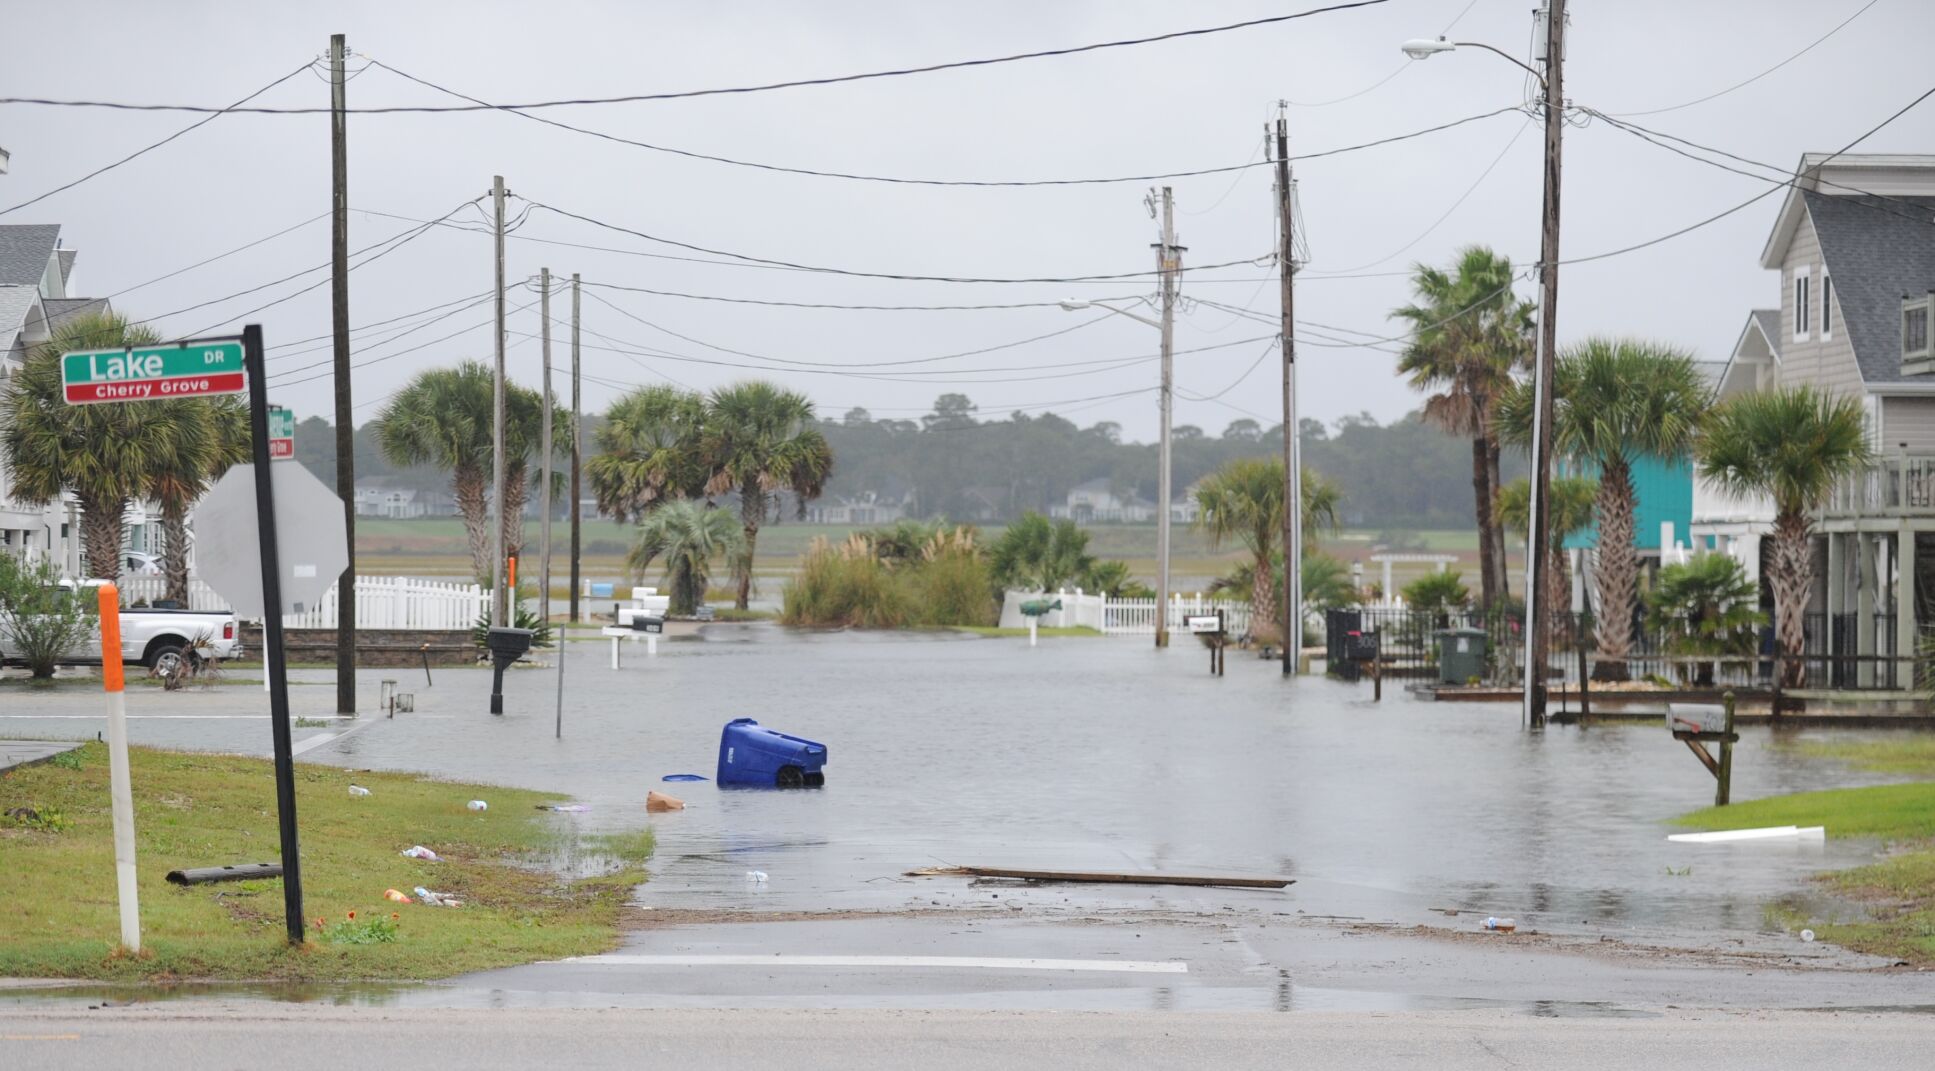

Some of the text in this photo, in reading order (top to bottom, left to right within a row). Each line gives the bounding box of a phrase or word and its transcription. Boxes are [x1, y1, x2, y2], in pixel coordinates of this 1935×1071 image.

[89, 350, 224, 381] Lake DR
[96, 380, 209, 399] Cherry Grove
